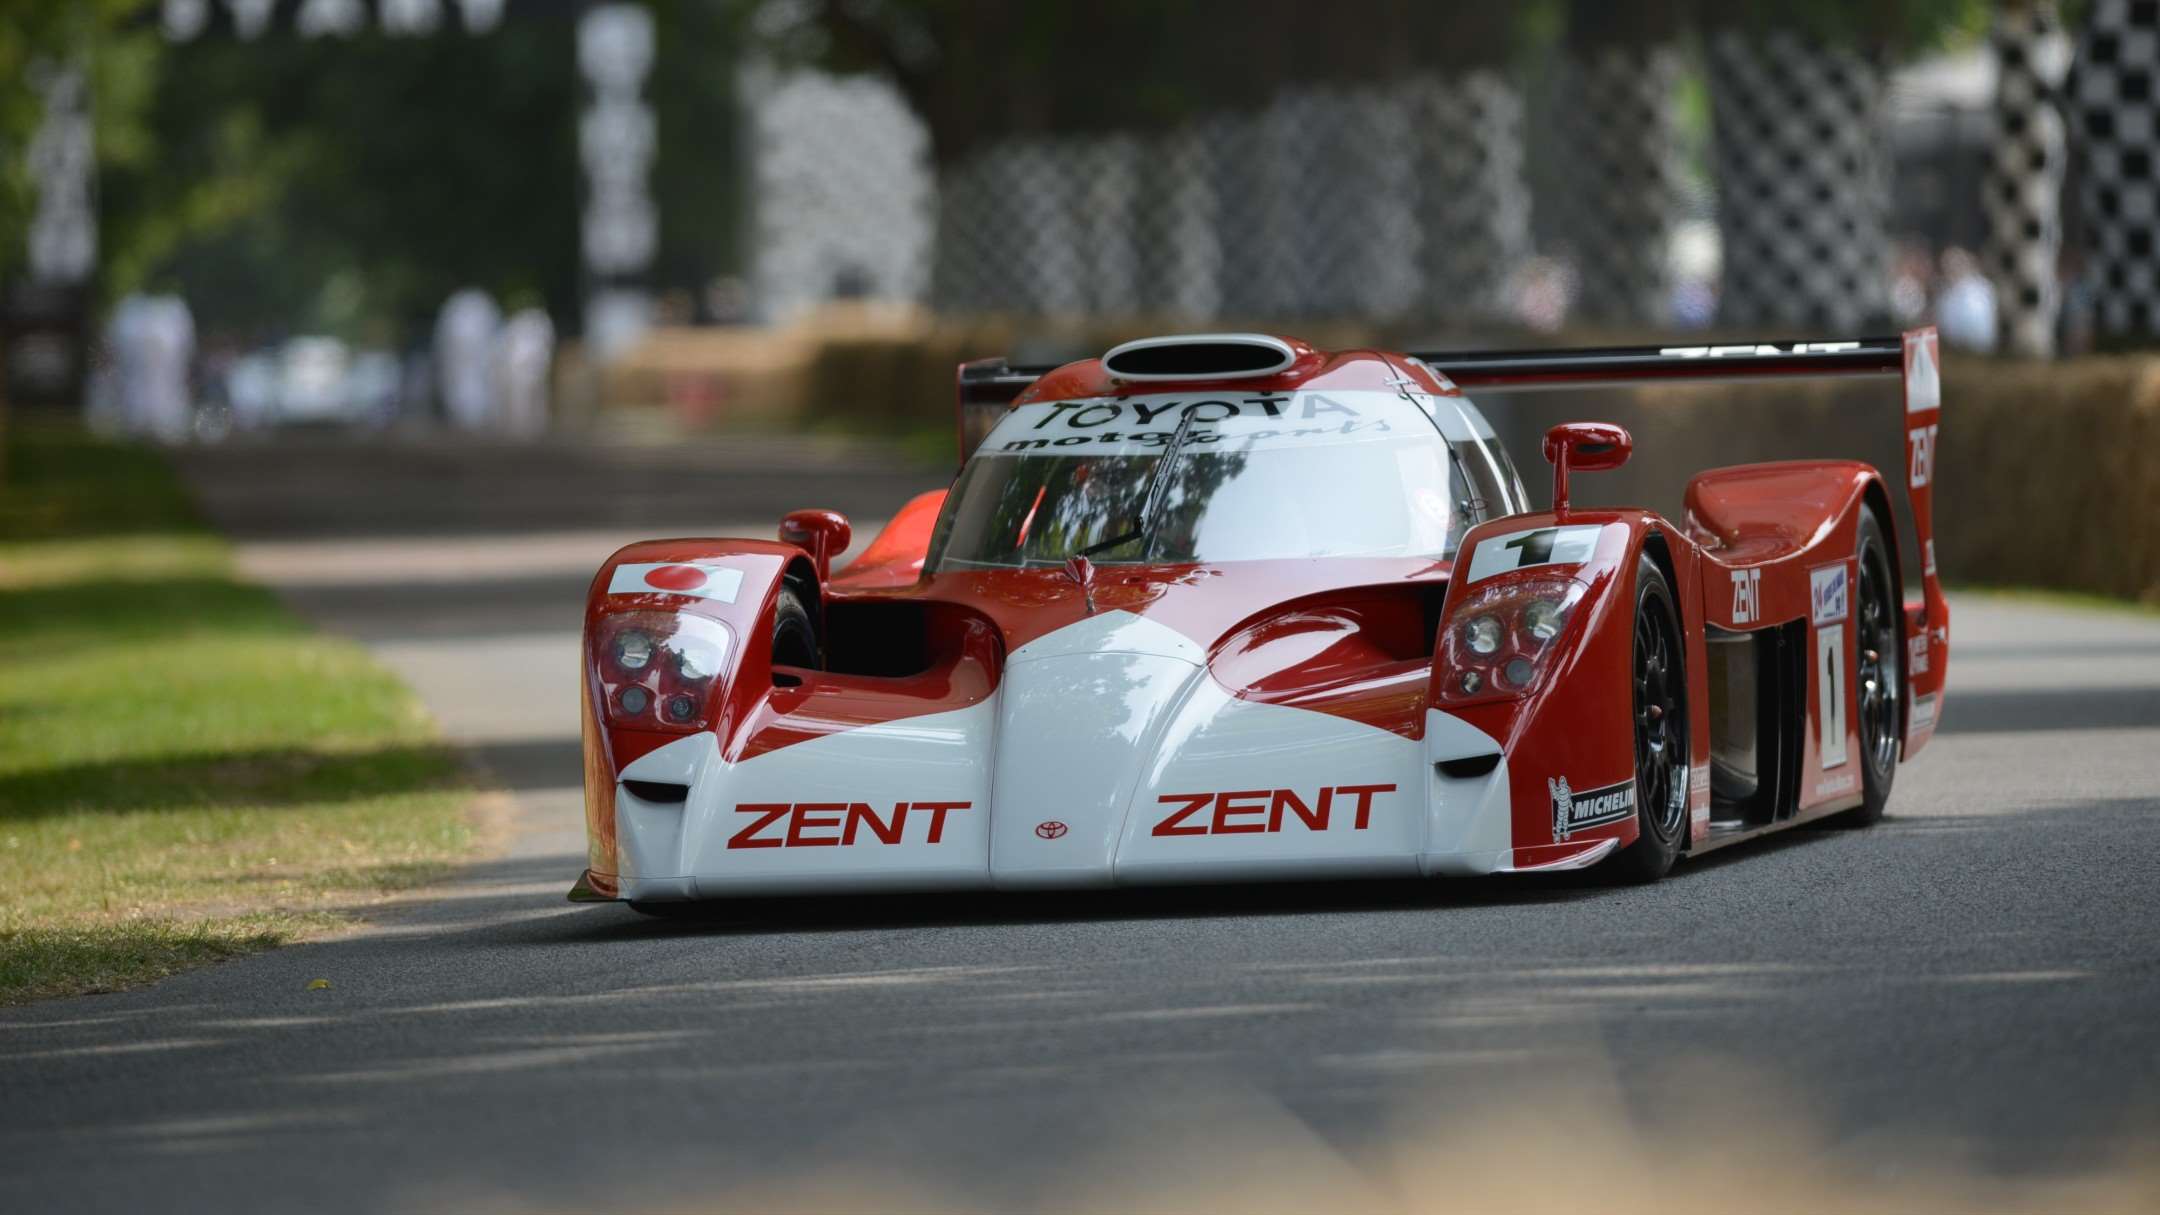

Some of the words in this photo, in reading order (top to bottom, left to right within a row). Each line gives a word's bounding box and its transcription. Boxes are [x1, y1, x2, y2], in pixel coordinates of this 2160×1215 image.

[1033, 394, 1359, 429] TOYOTA
[1505, 528, 1559, 567] 1
[1731, 568, 1761, 624] ZENT
[727, 801, 972, 850] ZENT
[1151, 783, 1397, 837] ZENT
[1574, 787, 1635, 820] MICHELIN
